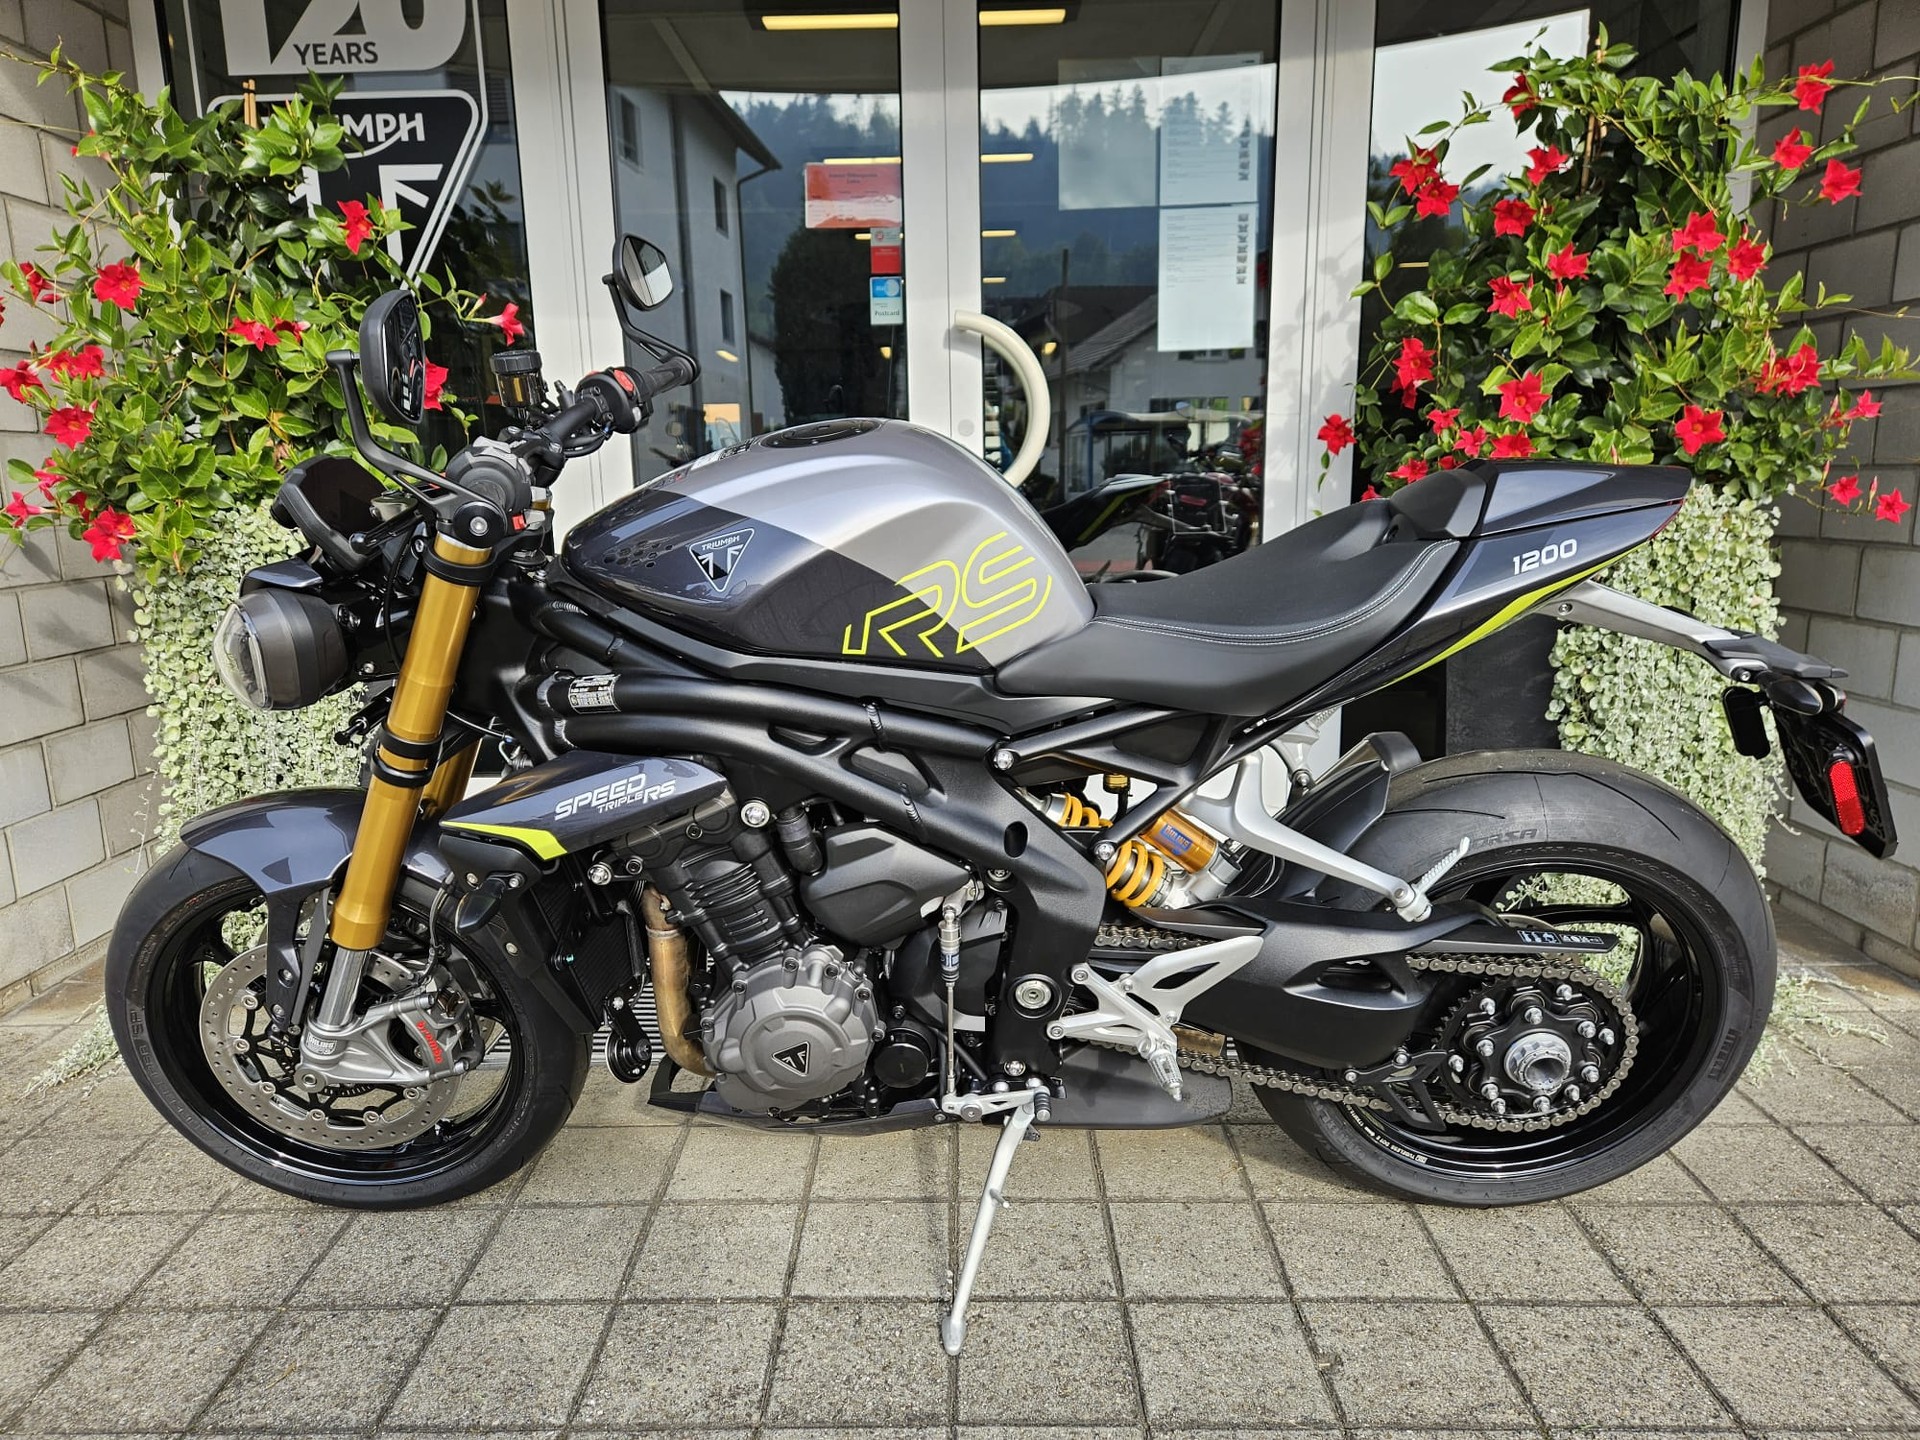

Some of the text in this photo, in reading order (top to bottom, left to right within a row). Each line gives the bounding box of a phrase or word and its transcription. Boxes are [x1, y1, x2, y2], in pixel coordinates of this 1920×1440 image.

[293, 41, 379, 66] YEARS
[701, 535, 740, 551] TRIUMPH
[1513, 539, 1577, 575] 1200
[842, 531, 1052, 658] RS
[554, 773, 647, 821] SPEED
[597, 780, 677, 814] TRIPLE RS
